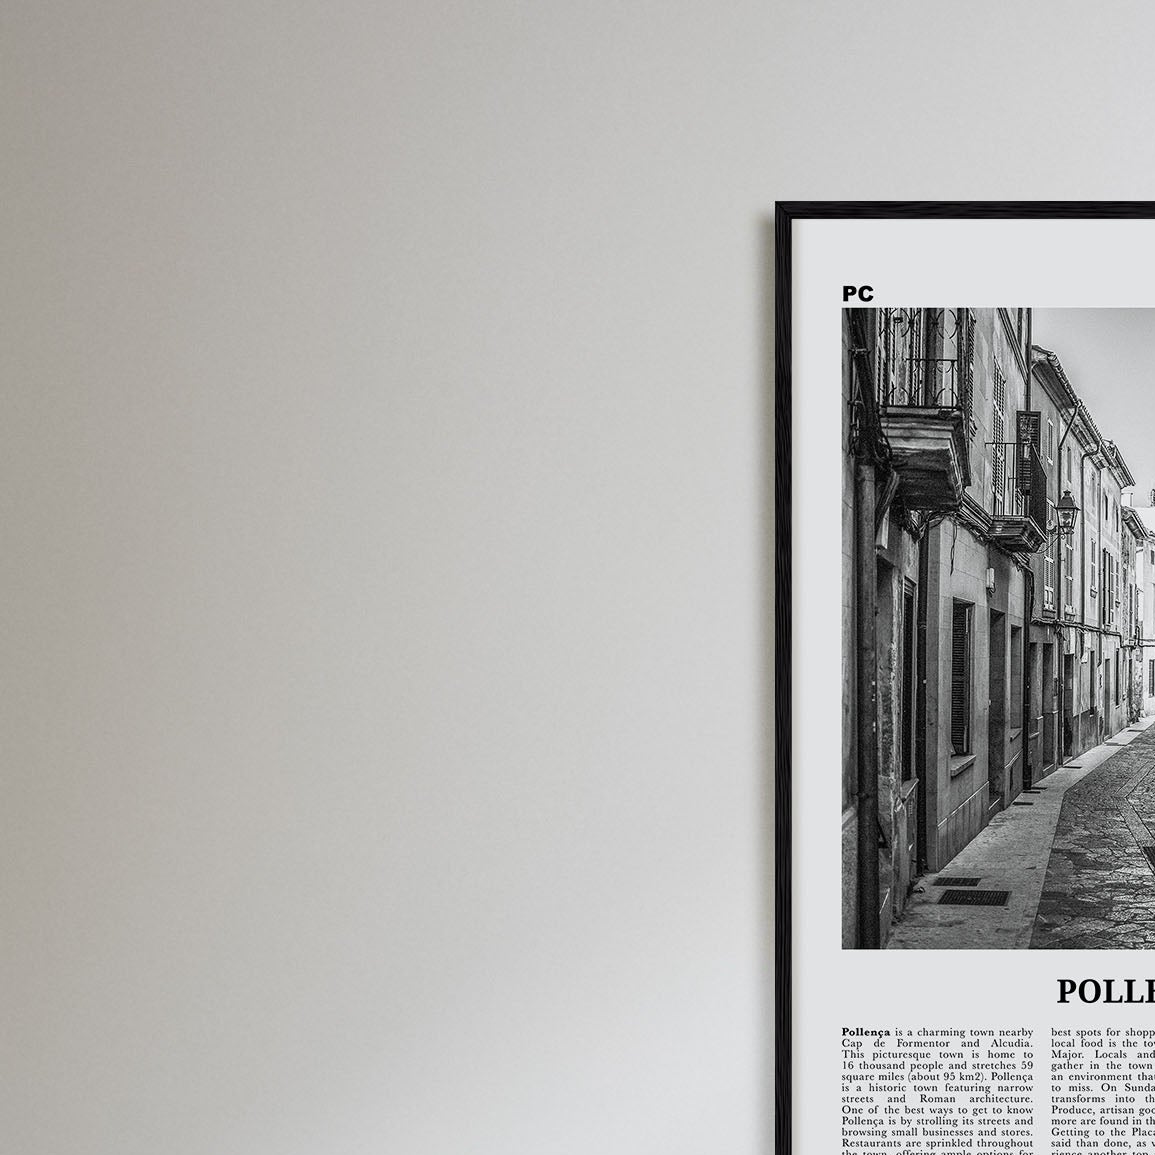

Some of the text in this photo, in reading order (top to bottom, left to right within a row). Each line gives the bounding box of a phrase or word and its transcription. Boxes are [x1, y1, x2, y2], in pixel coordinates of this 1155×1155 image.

[842, 284, 874, 303] PC
[842, 1028, 891, 1039] Pollença
[895, 1028, 903, 1037] is
[917, 1028, 966, 1039] charming
[970, 1028, 995, 1037] town
[999, 1028, 1034, 1039] nearby
[1051, 1028, 1071, 1037] best
[1076, 1028, 1102, 1039] spots
[1106, 1028, 1121, 1037] for
[842, 1039, 1033, 1050] Cap de Formentor and Alcudia.
[1051, 1039, 1075, 1048] local
[1081, 1039, 1103, 1048] food
[1109, 1039, 1117, 1048] is
[1122, 1039, 1138, 1048] the
[1051, 1050, 1084, 1062] Major.
[1095, 1050, 1128, 1059] Locals
[1137, 1050, 1155, 1059] and
[843, 1061, 1034, 1073] 16 thousand people and stretches 59
[1051, 1061, 1084, 1073] gather
[1090, 1061, 1100, 1070] in
[1106, 1061, 1122, 1070] the
[1128, 1062, 1153, 1070] town
[842, 1072, 1034, 1084] square miles (about 95 km2). Pollença
[842, 1094, 1033, 1103] streets and Roman architecture.
[1052, 1105, 1096, 1116] Produce,
[1100, 1105, 1135, 1114] artisan
[842, 1116, 1034, 1128] Pollença is by strolling its streets and
[1100, 1116, 1129, 1125] found
[1132, 1116, 1142, 1125] in
[842, 1128, 1033, 1139] browsing small businesses and stores.
[842, 1139, 902, 1148] Restaurants
[926, 1139, 973, 1150] sprinkled
[977, 1139, 1033, 1150] throughout
[1051, 1139, 1071, 1148] said
[1076, 1139, 1099, 1148] than
[1104, 1139, 1132, 1149] done,
